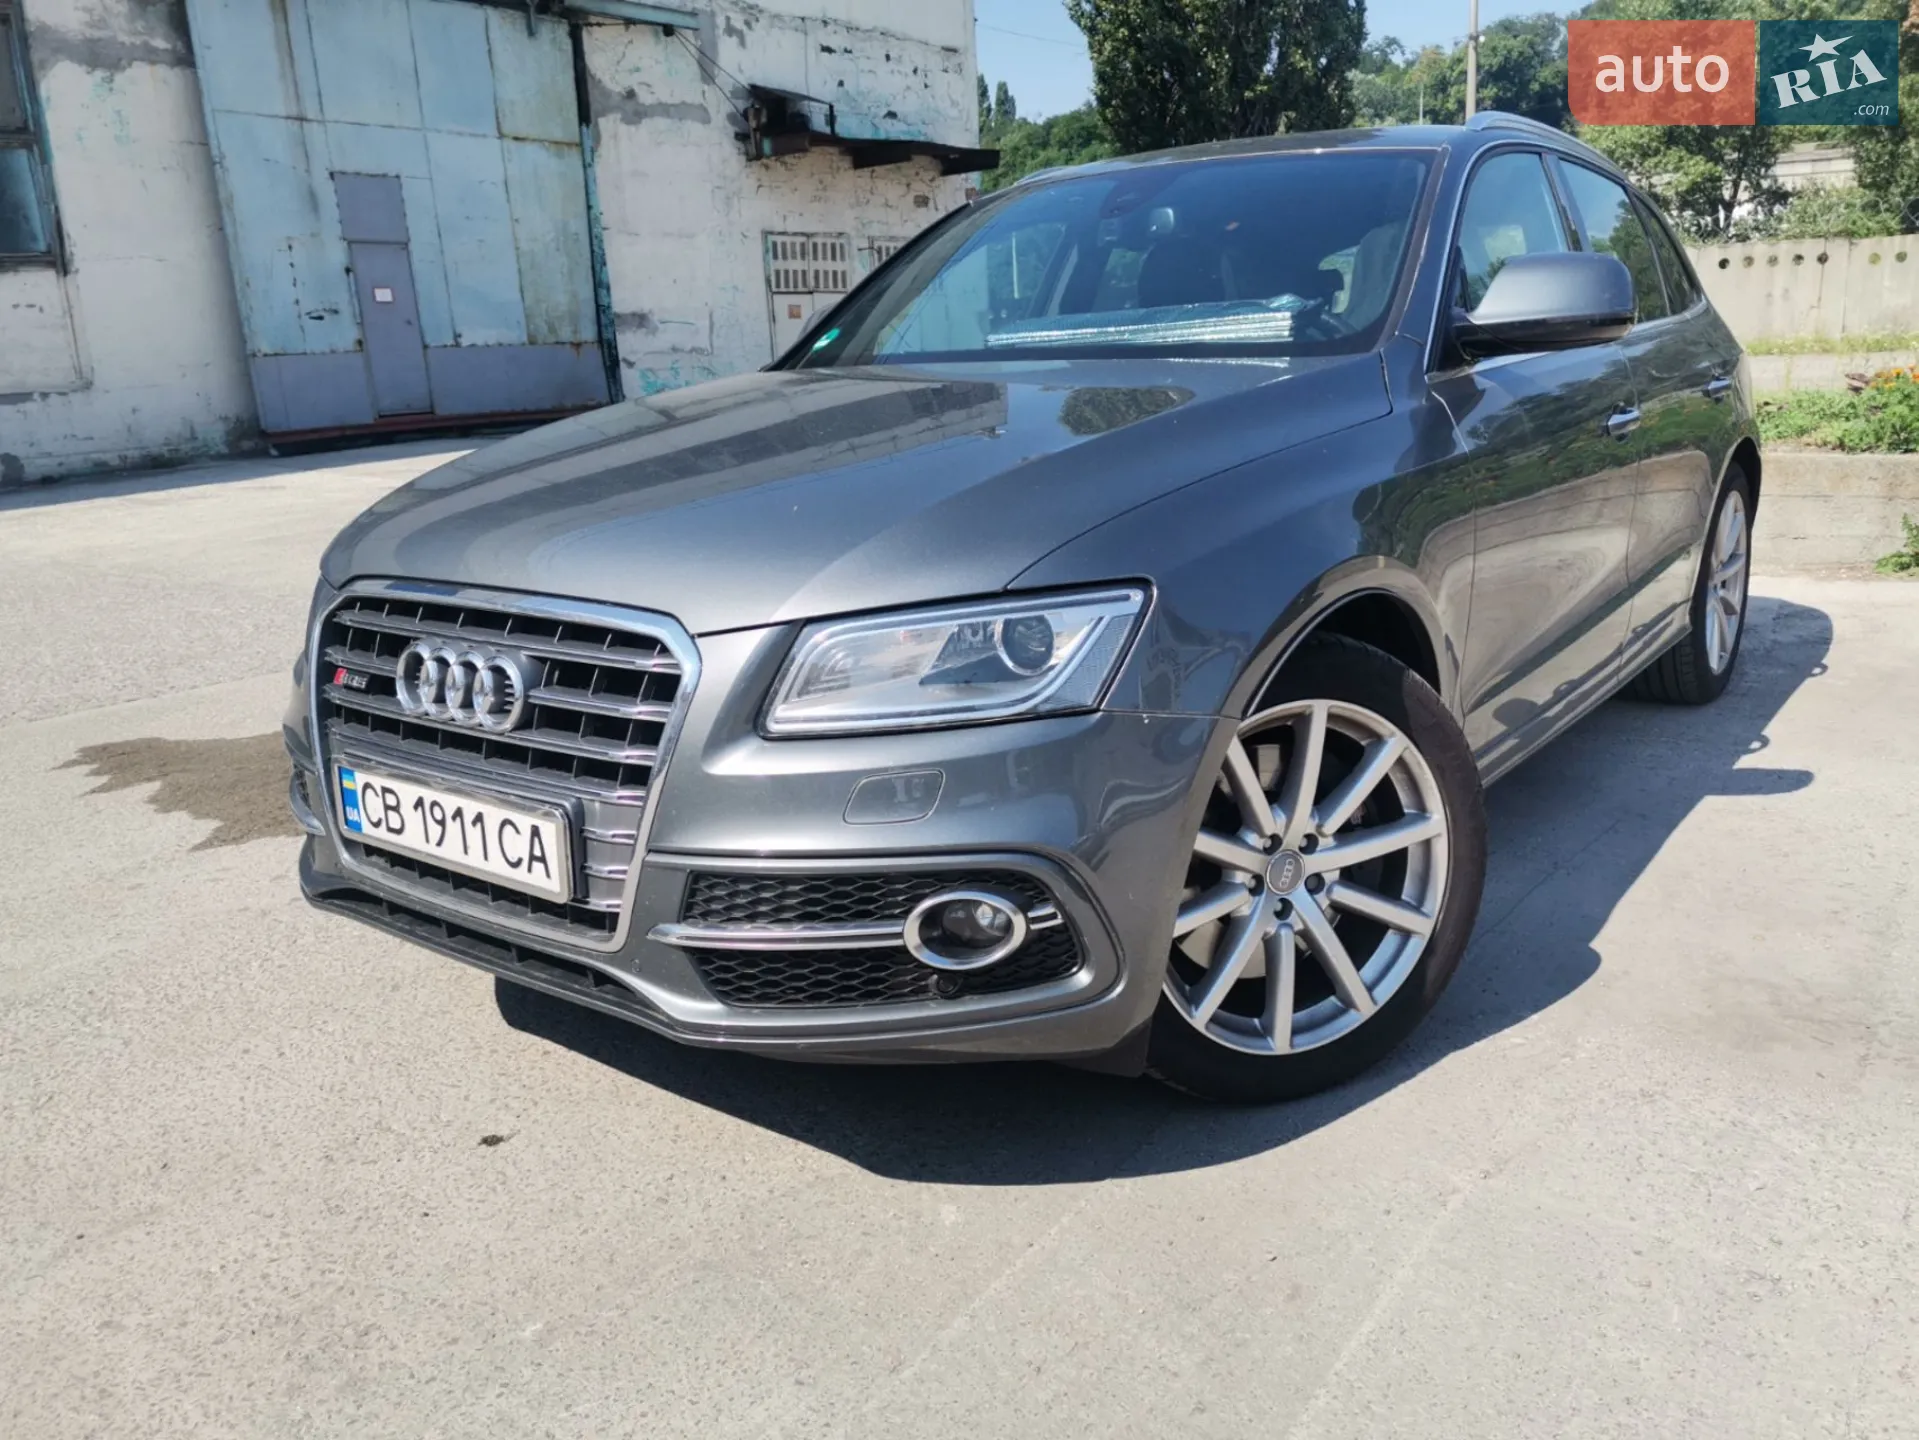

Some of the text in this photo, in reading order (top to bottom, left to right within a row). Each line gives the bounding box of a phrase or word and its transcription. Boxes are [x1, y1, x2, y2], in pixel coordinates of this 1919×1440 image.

[346, 805, 361, 822] UA
[361, 782, 551, 879] CB 1911 CA
